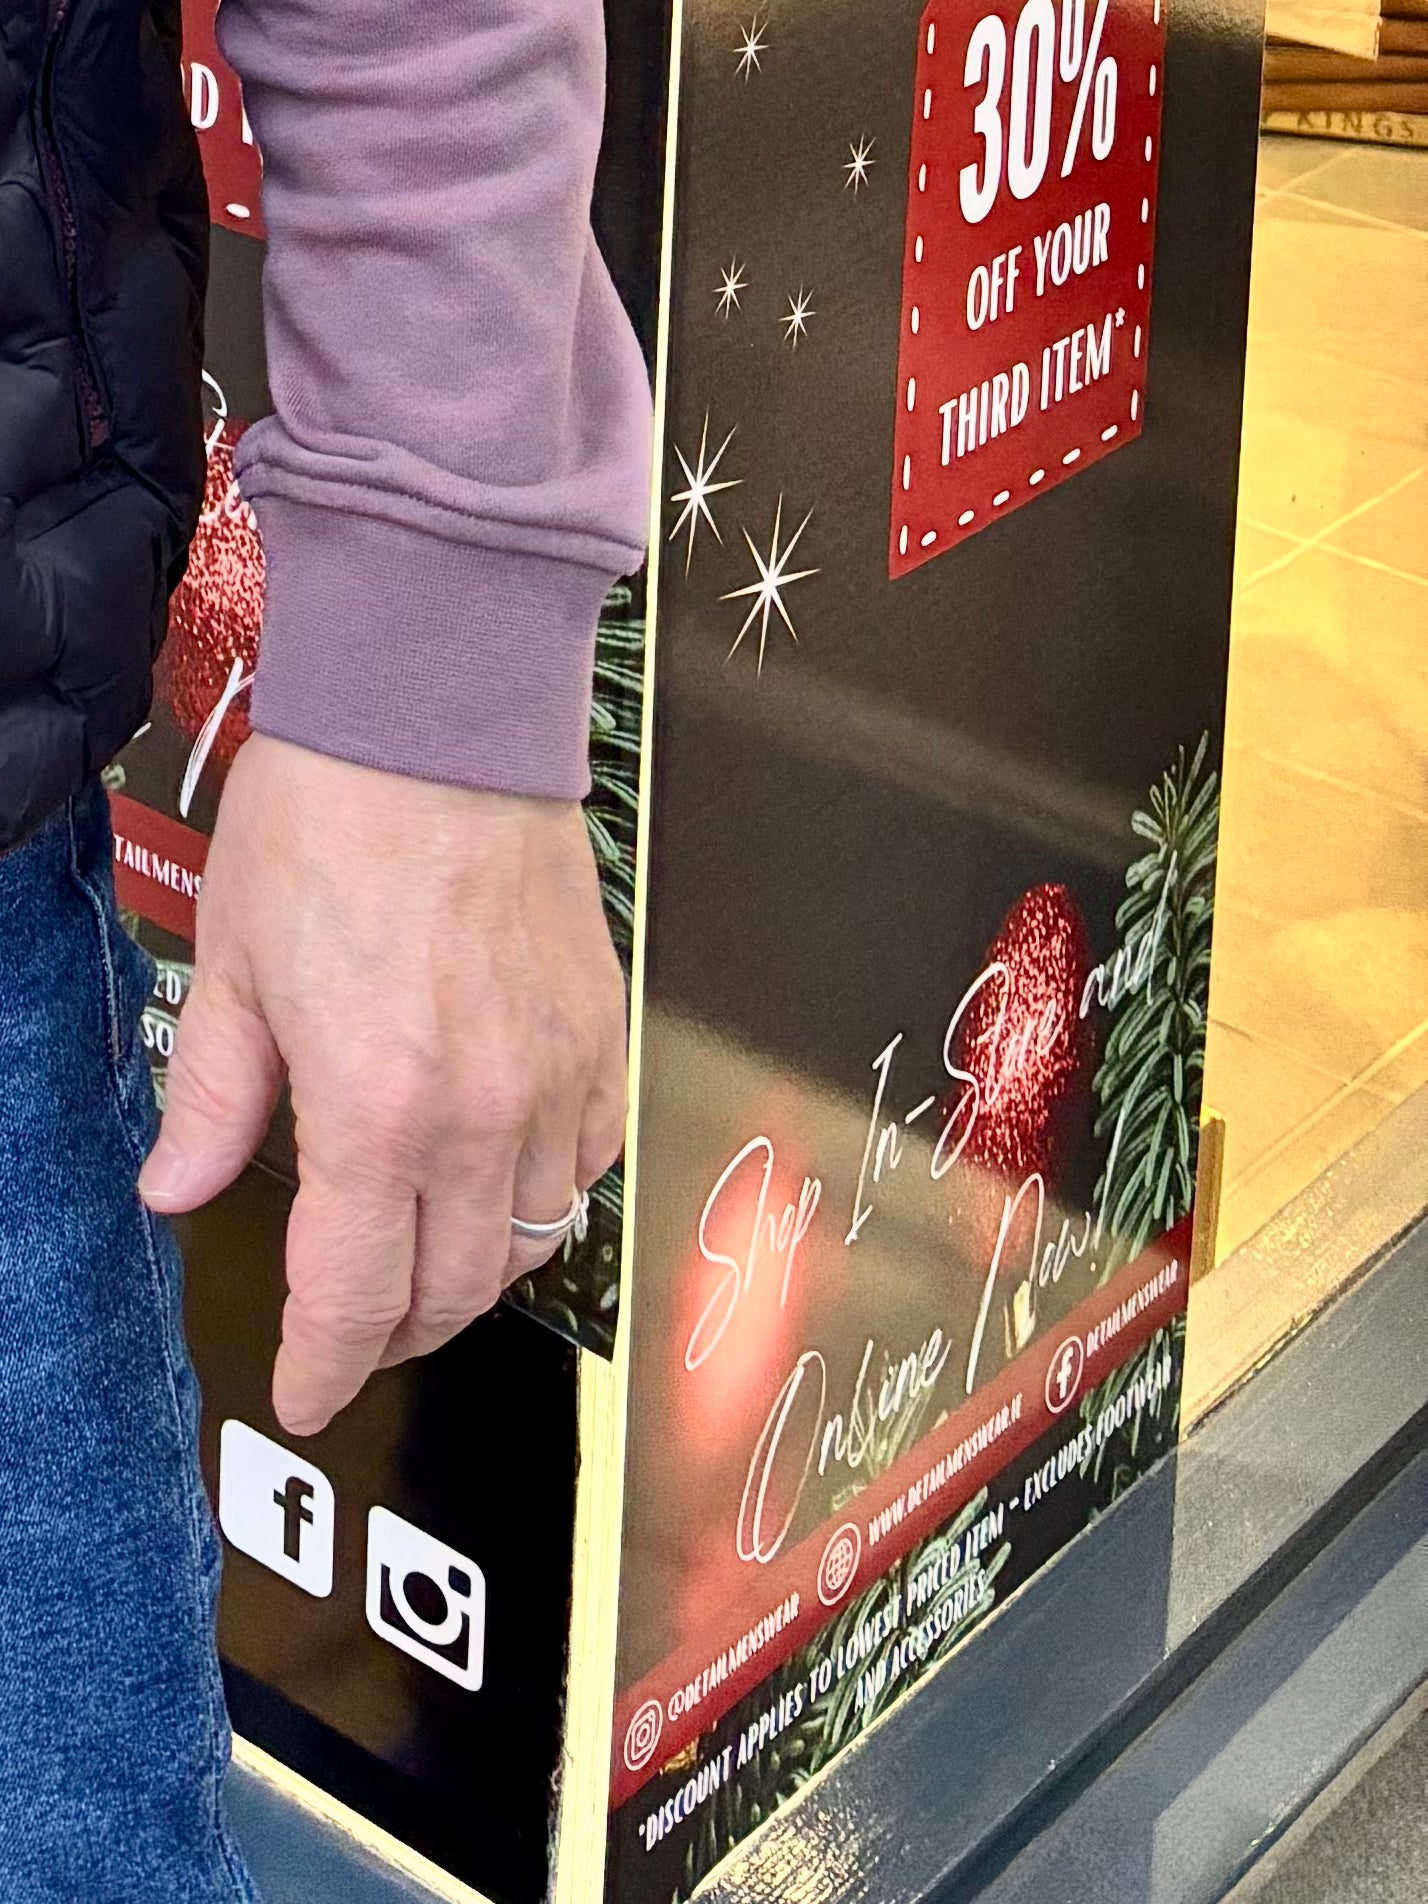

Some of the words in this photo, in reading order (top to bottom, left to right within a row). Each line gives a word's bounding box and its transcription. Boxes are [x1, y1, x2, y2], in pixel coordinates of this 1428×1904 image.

[966, 244, 1021, 330] OFF
[1033, 202, 1110, 296] YOUR
[938, 361, 1030, 466] THIRD
[114, 833, 201, 899] TAILMENS
[685, 1136, 821, 1370] Shop
[844, 961, 1061, 1246] In-Store
[668, 1592, 799, 1722] @DETAILMENSWEAR
[868, 1393, 1022, 1546] WWW.DETAILMENSWEAR.IE
[1086, 1259, 1178, 1356] DETAILMENSWEAR
[736, 1329, 951, 1563] Online
[737, 1684, 803, 1770] APPLIES
[810, 1658, 832, 1703] TO
[836, 1594, 902, 1675] LOWEST
[907, 1542, 961, 1616] PRICED
[965, 1502, 1004, 1569] ITEM
[1023, 1424, 1093, 1511] EXCLUDES
[1095, 1353, 1172, 1446] FOOTWEAR
[855, 1658, 887, 1712] AND
[889, 1567, 987, 1683] ACCESSORIES
